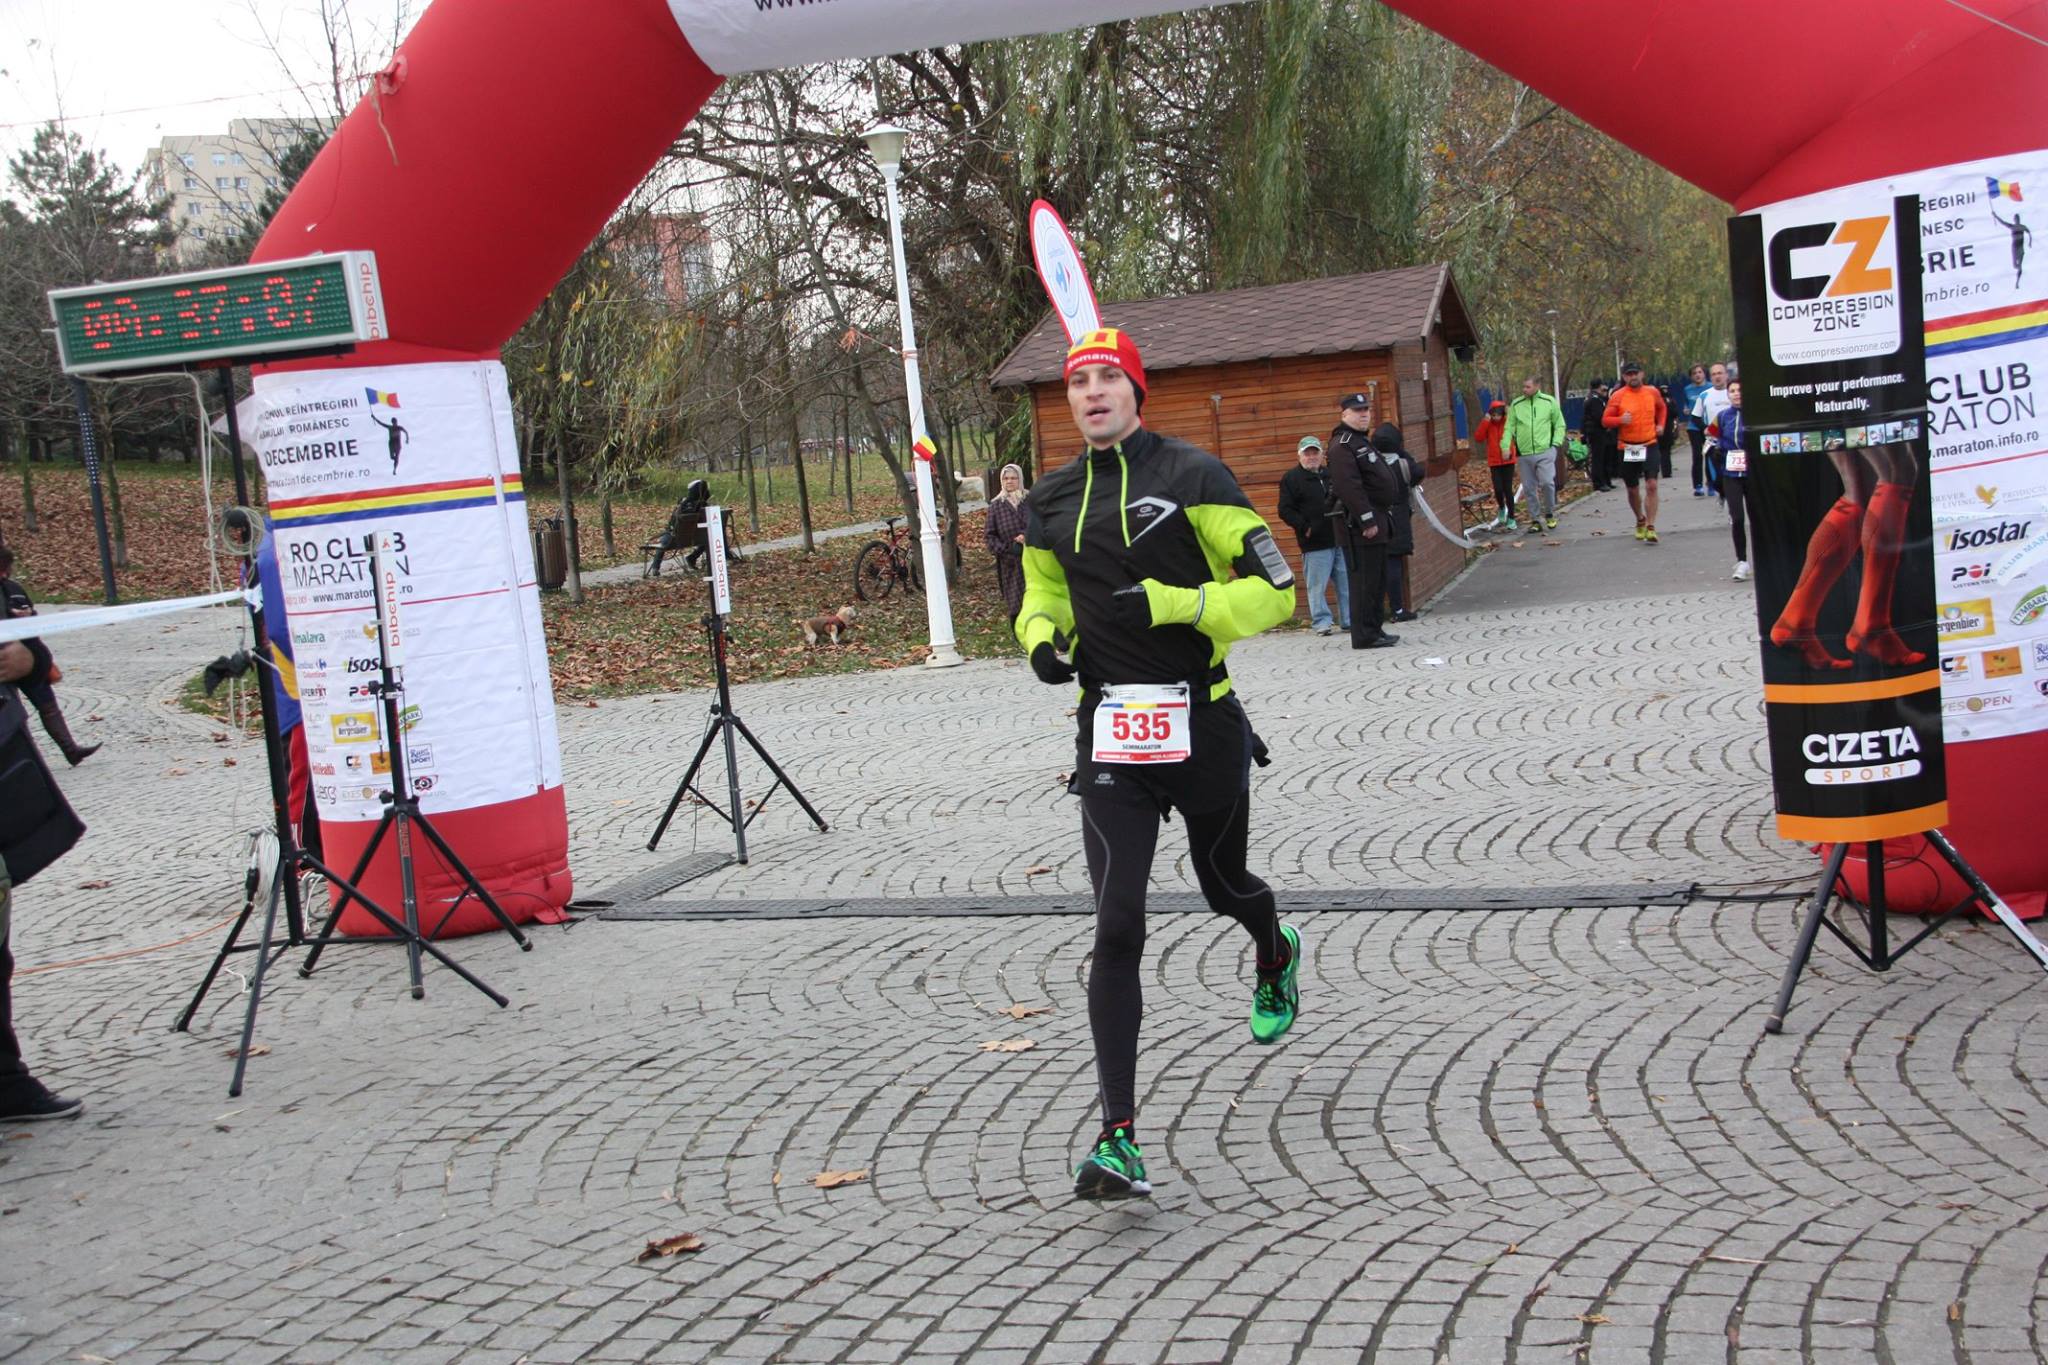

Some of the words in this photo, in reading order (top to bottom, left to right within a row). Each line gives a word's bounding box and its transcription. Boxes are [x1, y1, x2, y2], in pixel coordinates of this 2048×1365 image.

[1768, 215, 1893, 302] CZ
[360, 262, 381, 341] bibchip
[1773, 295, 1894, 321] COMPRESSION
[1067, 353, 1120, 370] Romania
[1776, 340, 1897, 361] www.compressionzone.com
[1769, 384, 1812, 398] Improve
[1815, 381, 1840, 396] your
[1842, 373, 1905, 393] performance.
[1928, 361, 2032, 404] CLUB
[1814, 397, 1870, 413] Naturally.
[264, 438, 359, 467] DECEMBRIE
[1949, 520, 2031, 551] isostar
[290, 541, 319, 564] RO
[293, 555, 410, 588] MARATN
[386, 571, 400, 648] bibchip
[1112, 712, 1171, 742] 535
[1802, 726, 1921, 764] CIZETA
[1823, 763, 1906, 784] SPORT
